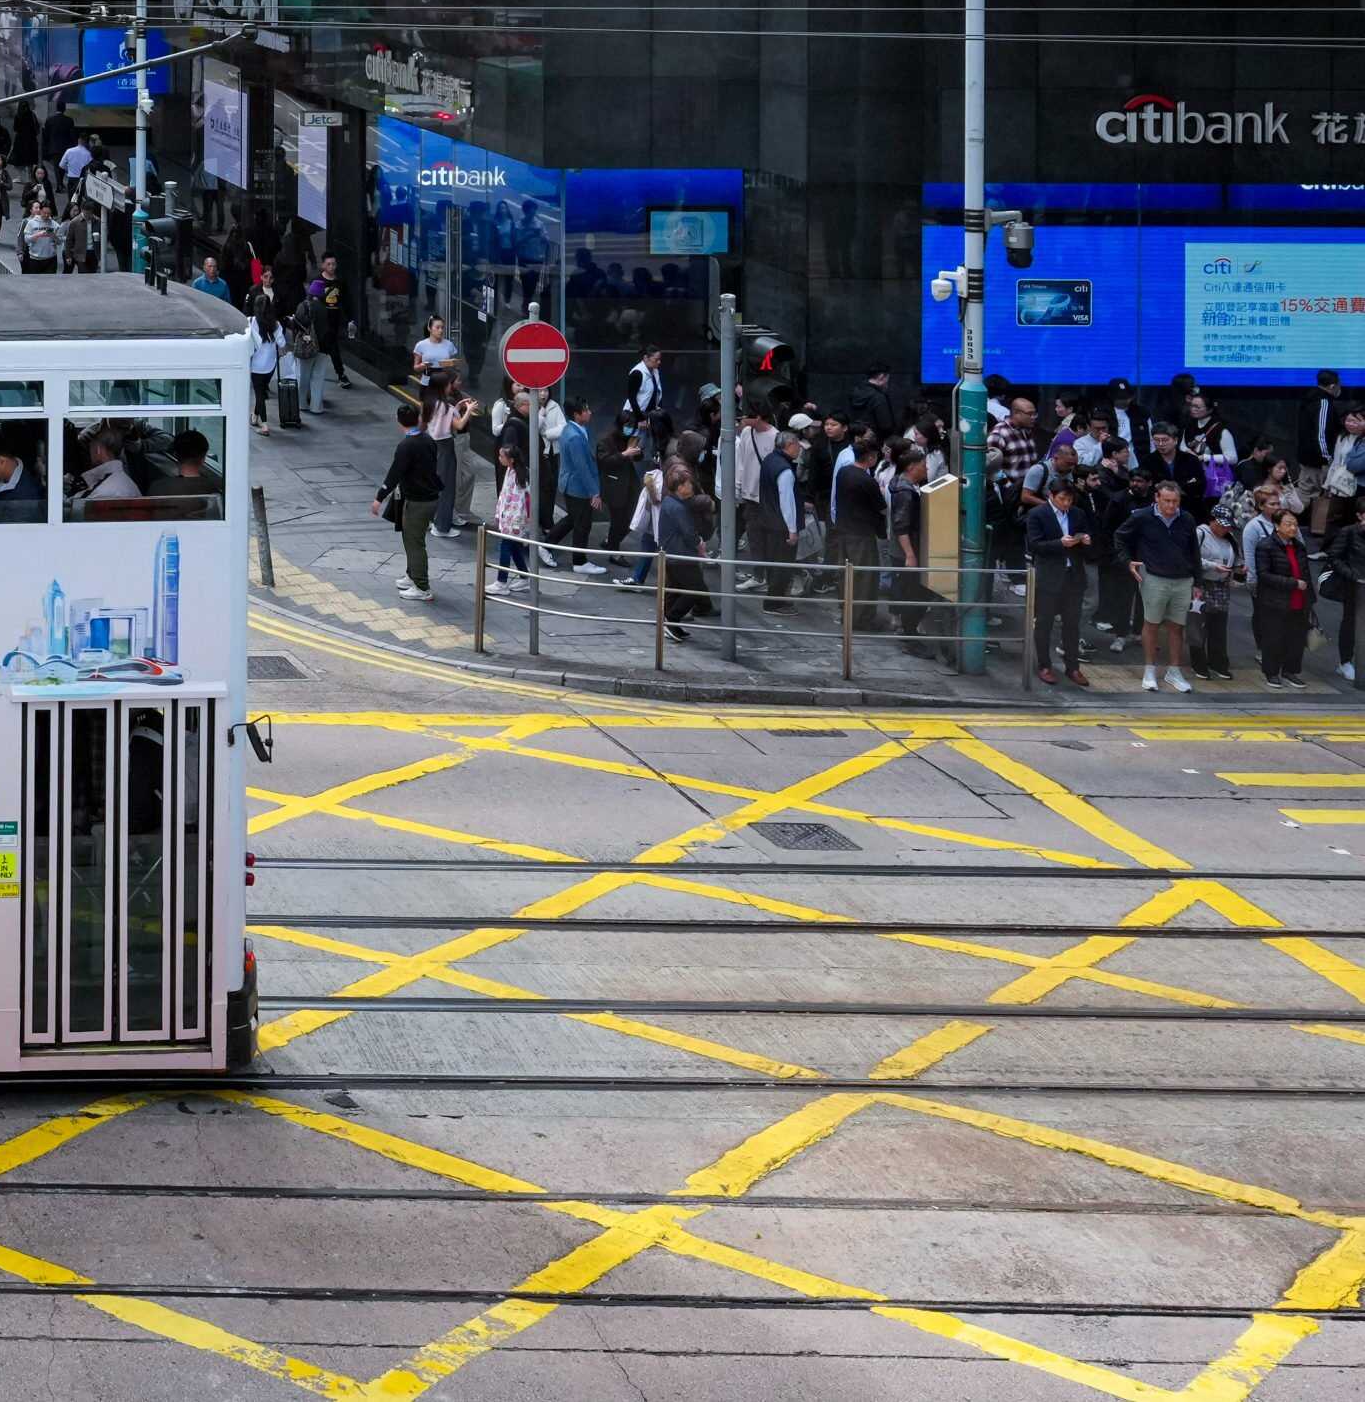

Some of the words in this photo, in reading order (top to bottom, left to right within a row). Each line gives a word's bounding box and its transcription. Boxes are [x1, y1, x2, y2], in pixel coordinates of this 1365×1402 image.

[1095, 100, 1291, 144] citibank
[1311, 111, 1365, 145] 花
[417, 165, 507, 187] citibank
[1203, 259, 1232, 275] citi
[1074, 285, 1089, 294] citi
[1073, 314, 1089, 322] VISA
